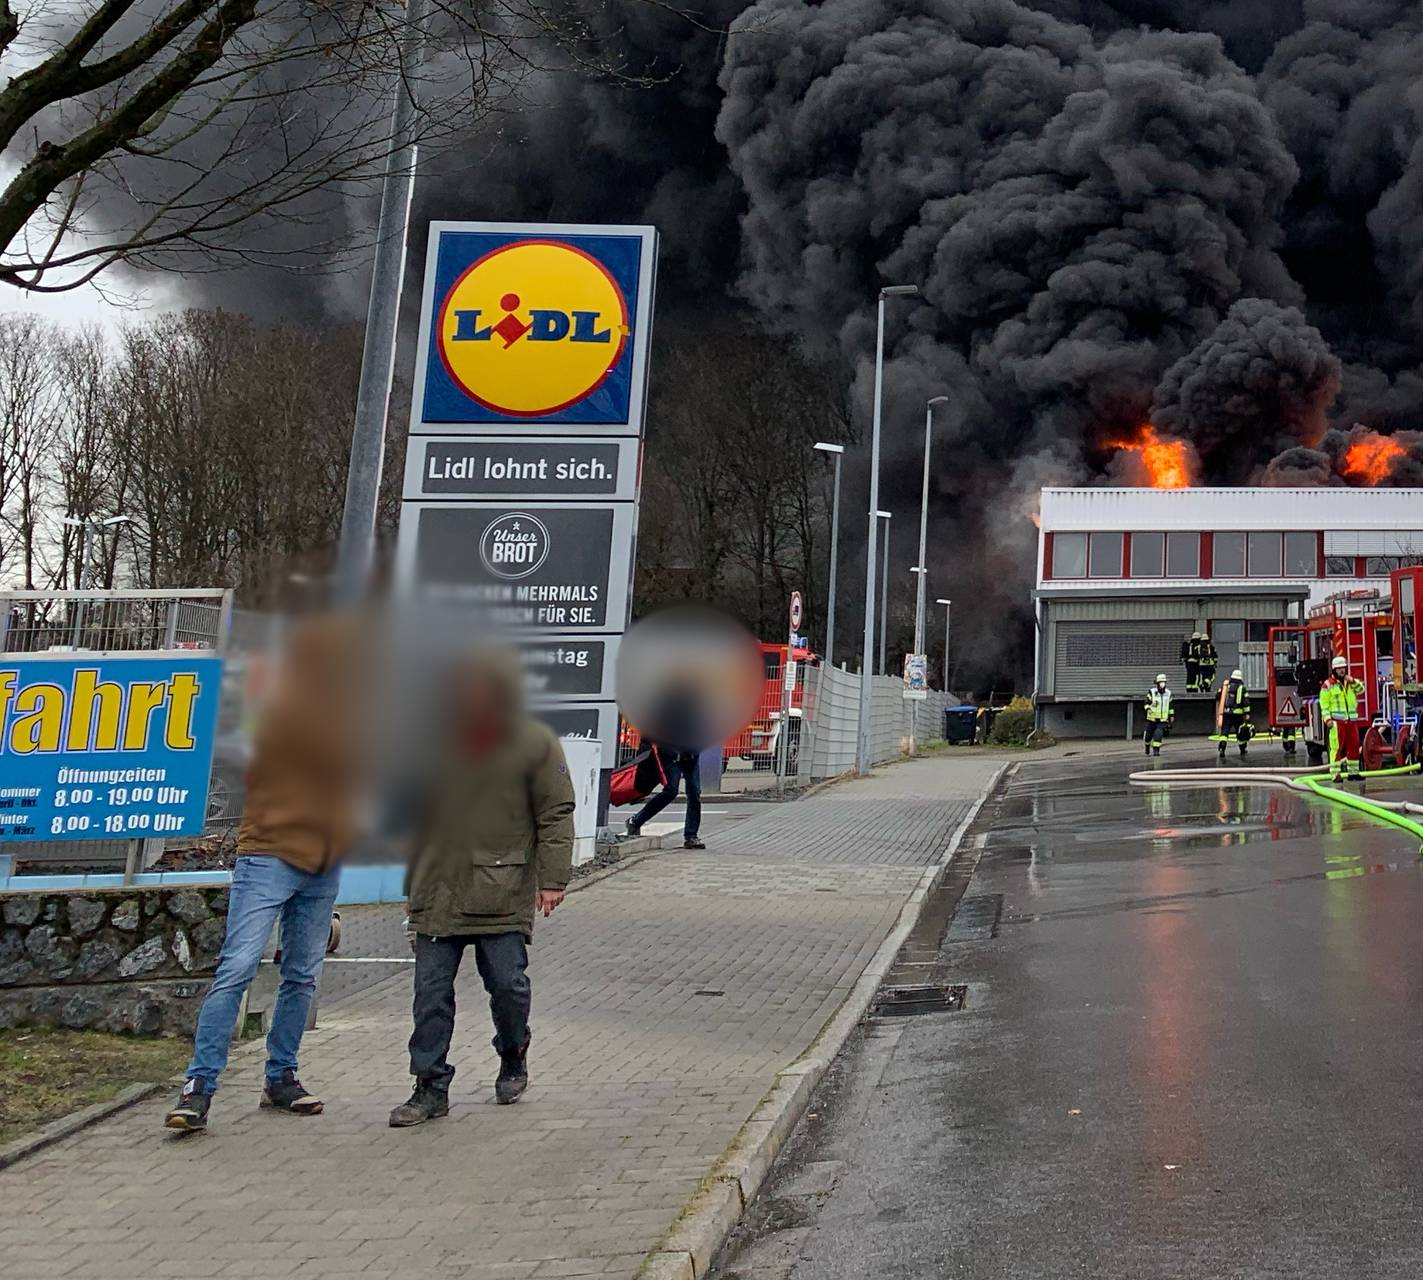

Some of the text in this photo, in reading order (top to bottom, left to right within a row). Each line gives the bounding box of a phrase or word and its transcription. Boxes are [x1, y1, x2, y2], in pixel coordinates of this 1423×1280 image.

[428, 457, 612, 480] Lidl lohnt sich.
[493, 529, 538, 542] Unser
[492, 542, 538, 563] BROT
[516, 585, 598, 602] MEHRMALS
[537, 604, 566, 623] FÜR
[569, 607, 597, 623] SIE.
[57, 766, 166, 785] Öffnungzeiten
[0, 788, 41, 798] ommer
[54, 789, 93, 807] 8.00
[107, 787, 153, 805] 19.00
[157, 786, 189, 804] Uhr
[0, 813, 28, 825] inter
[50, 816, 90, 834] 8.00
[103, 814, 150, 833] 18.00
[153, 814, 185, 832] Uhr
